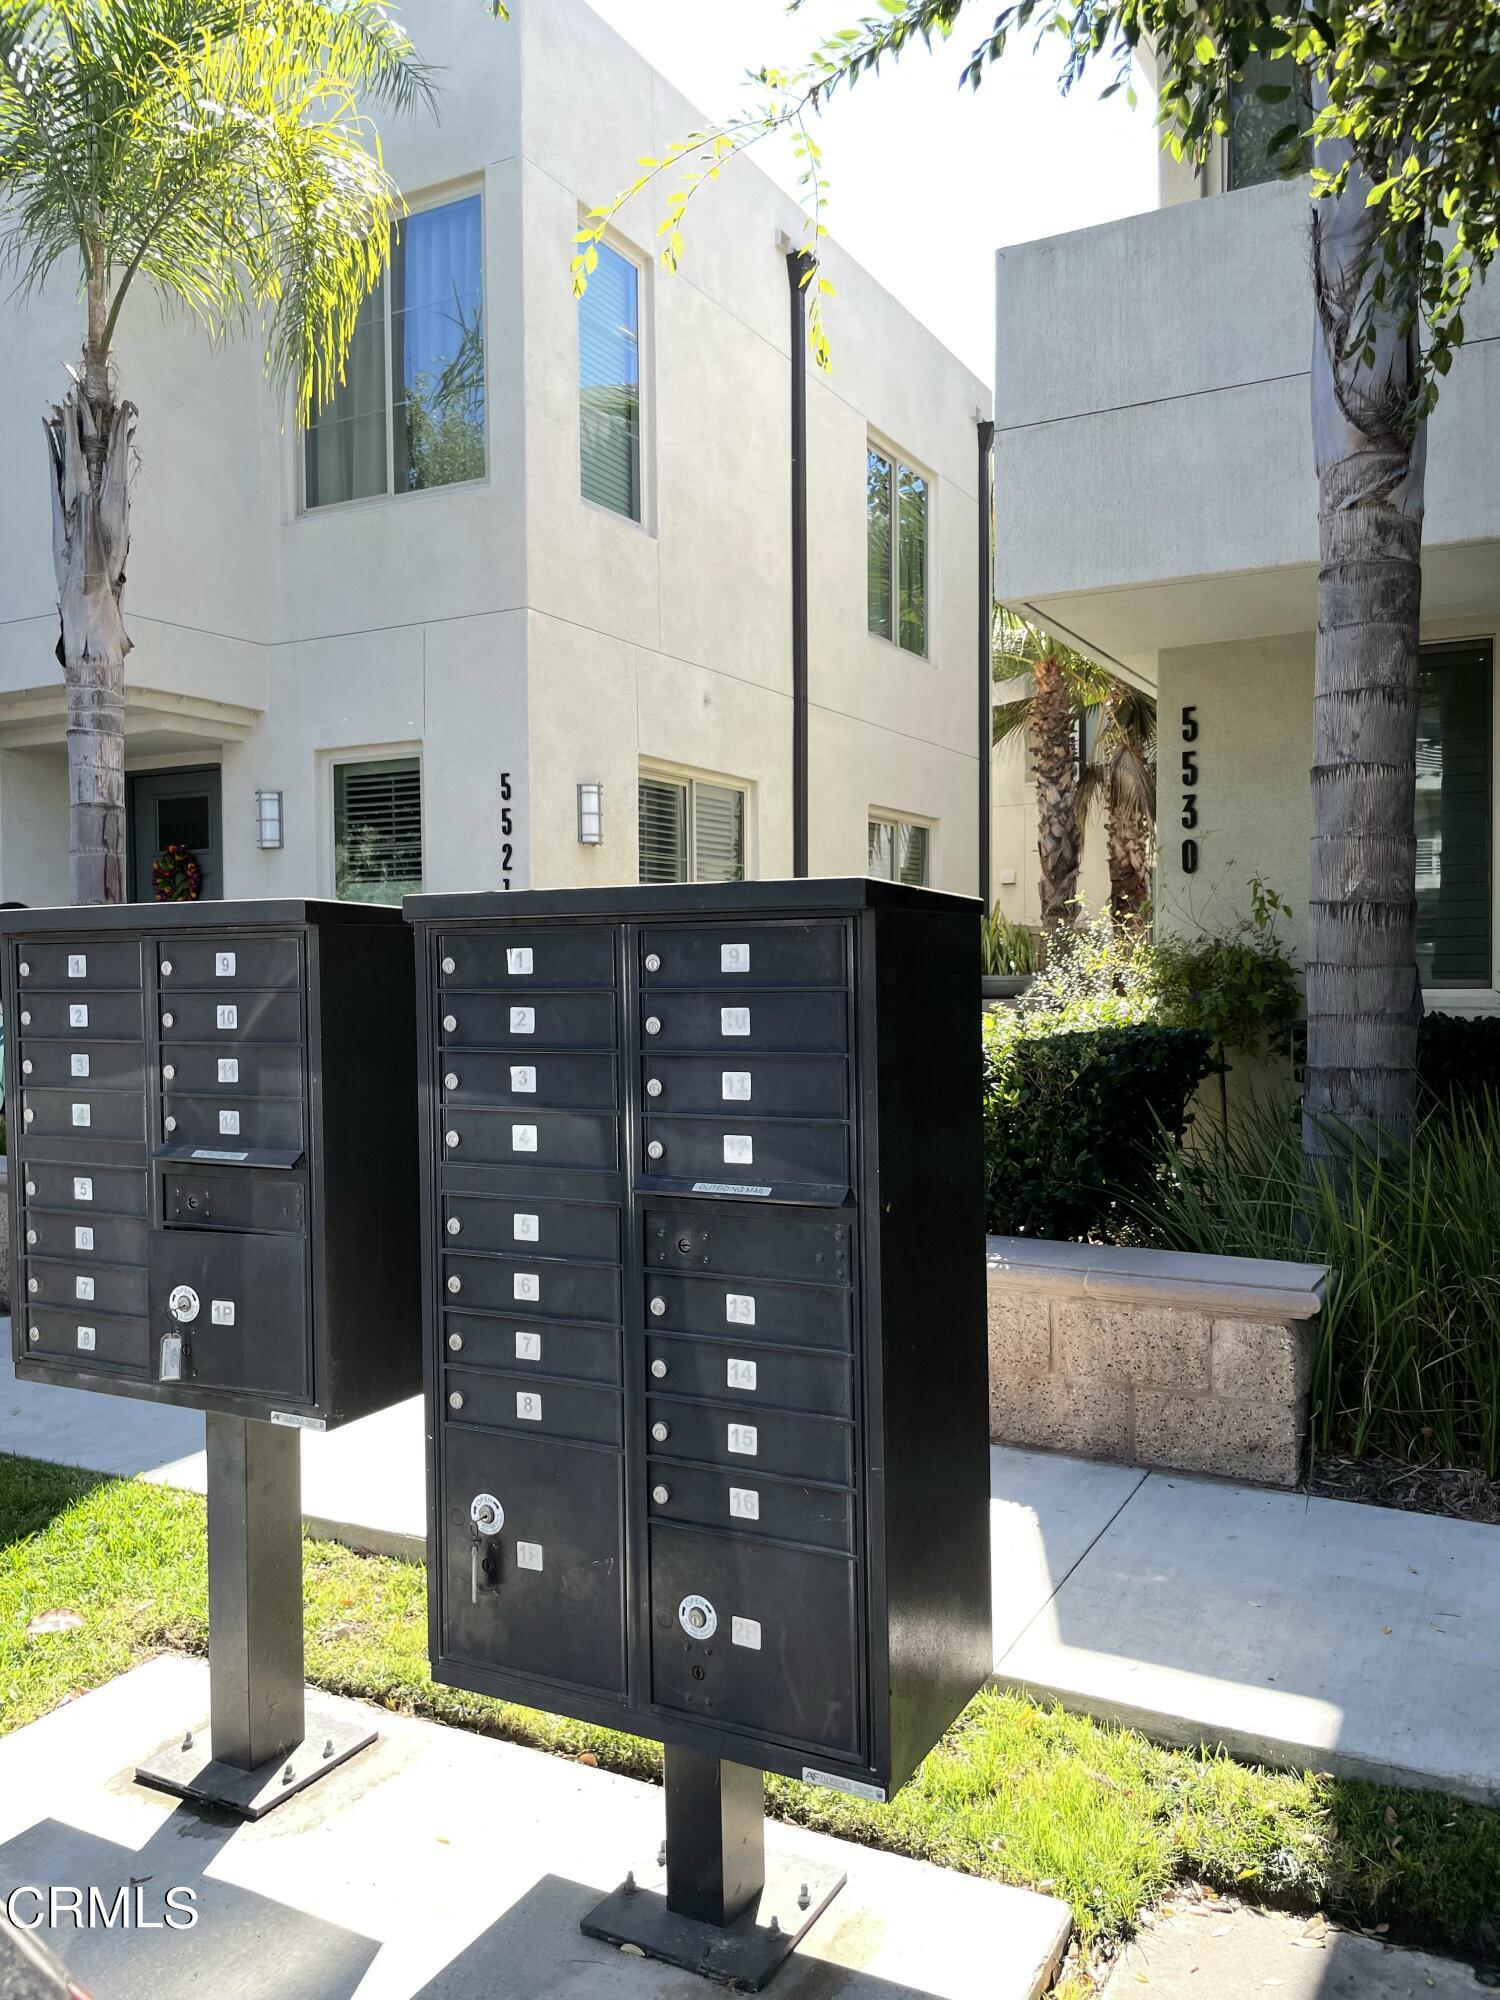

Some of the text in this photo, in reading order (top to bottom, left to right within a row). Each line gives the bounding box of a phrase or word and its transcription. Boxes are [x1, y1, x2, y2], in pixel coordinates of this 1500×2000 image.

[1182, 706, 1198, 874] 5530
[221, 957, 230, 971] 9
[514, 952, 523, 968] 1
[728, 948, 741, 964] 9
[74, 1009, 83, 1023] 2
[220, 1010, 234, 1025] 10
[516, 1011, 527, 1027] 2
[75, 1059, 84, 1072] 3
[517, 1070, 528, 1086] 3
[519, 1128, 530, 1145] 4
[79, 1182, 88, 1196] 5
[699, 1184, 743, 1192] OUTGOING
[520, 1218, 530, 1234] 5
[80, 1231, 89, 1245] 6
[81, 1282, 89, 1295] 7
[176, 1287, 193, 1296] OPEN
[520, 1277, 531, 1293] 6
[214, 1305, 232, 1320] 1P
[730, 1298, 750, 1317] 13
[83, 1332, 91, 1345] 8
[521, 1336, 533, 1353] 7
[730, 1363, 752, 1382] 14
[523, 1396, 533, 1413] 8
[731, 1428, 753, 1447] 15
[476, 1496, 493, 1505] OPEN
[732, 1492, 754, 1512] 16
[685, 1598, 705, 1607] OPEN
